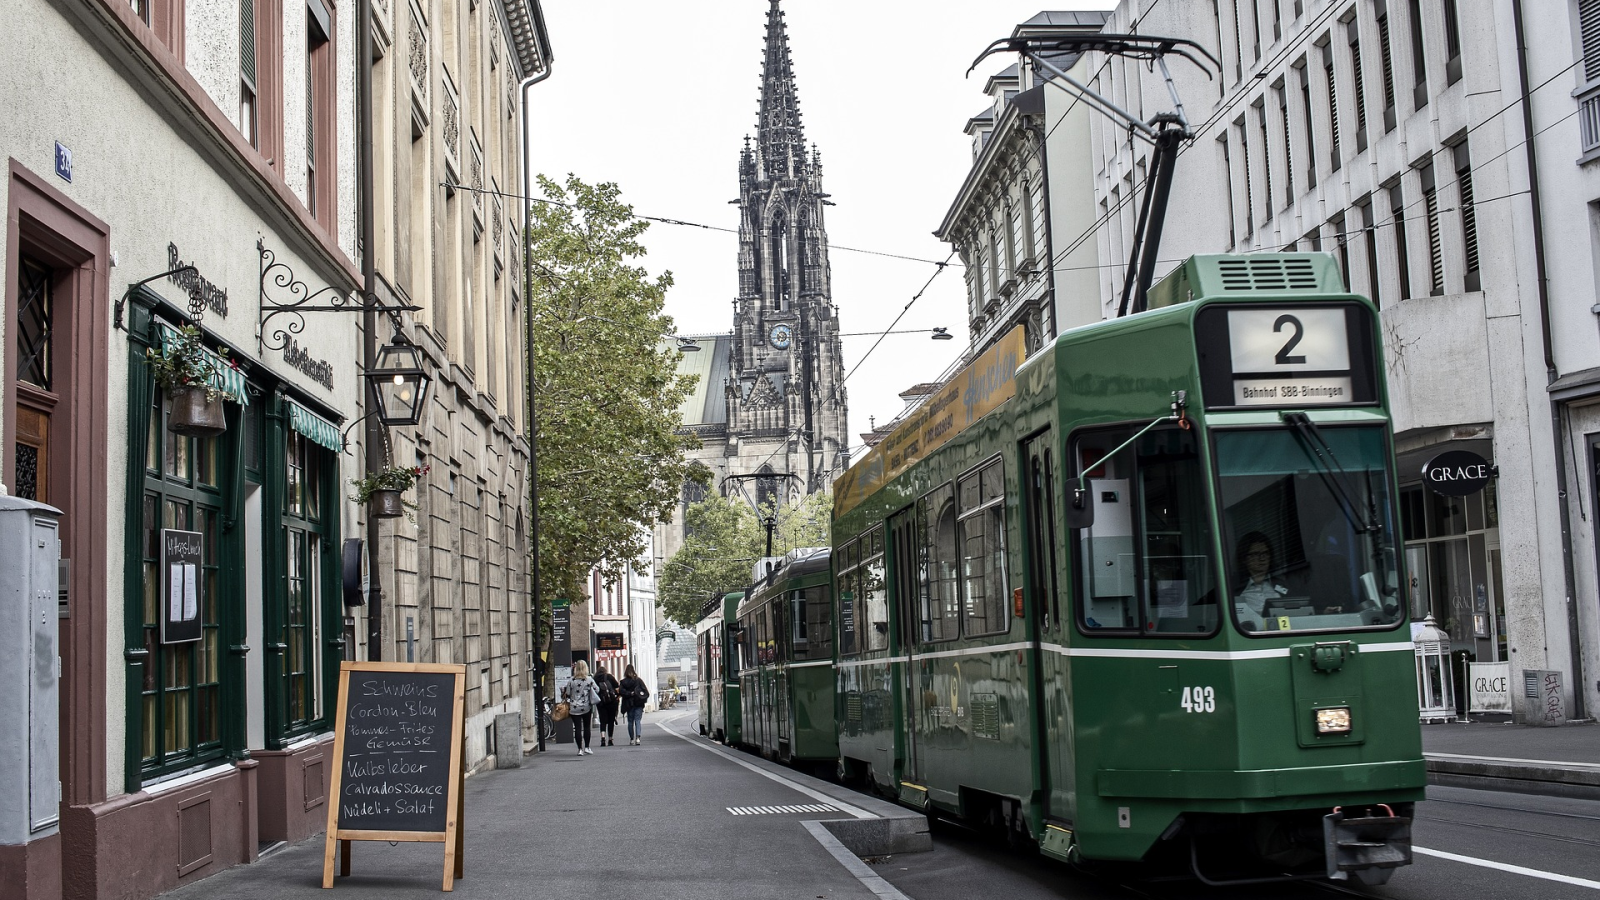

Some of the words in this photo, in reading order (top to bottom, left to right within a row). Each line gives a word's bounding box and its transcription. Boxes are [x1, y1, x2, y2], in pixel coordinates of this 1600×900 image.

[60, 150, 69, 174] 34
[1272, 313, 1306, 365] 2
[1242, 385, 1277, 399] Bahnhof
[1281, 384, 1344, 399] SBB-Binningen
[1430, 465, 1488, 482] GRACE
[1452, 595, 1471, 609] GRAC
[1281, 619, 1288, 628] 2
[362, 681, 439, 698] Schweins
[1474, 677, 1507, 693] GRACE
[1181, 685, 1216, 713] 493
[345, 781, 443, 796] Calvadossauce
[395, 798, 435, 815] Salat
